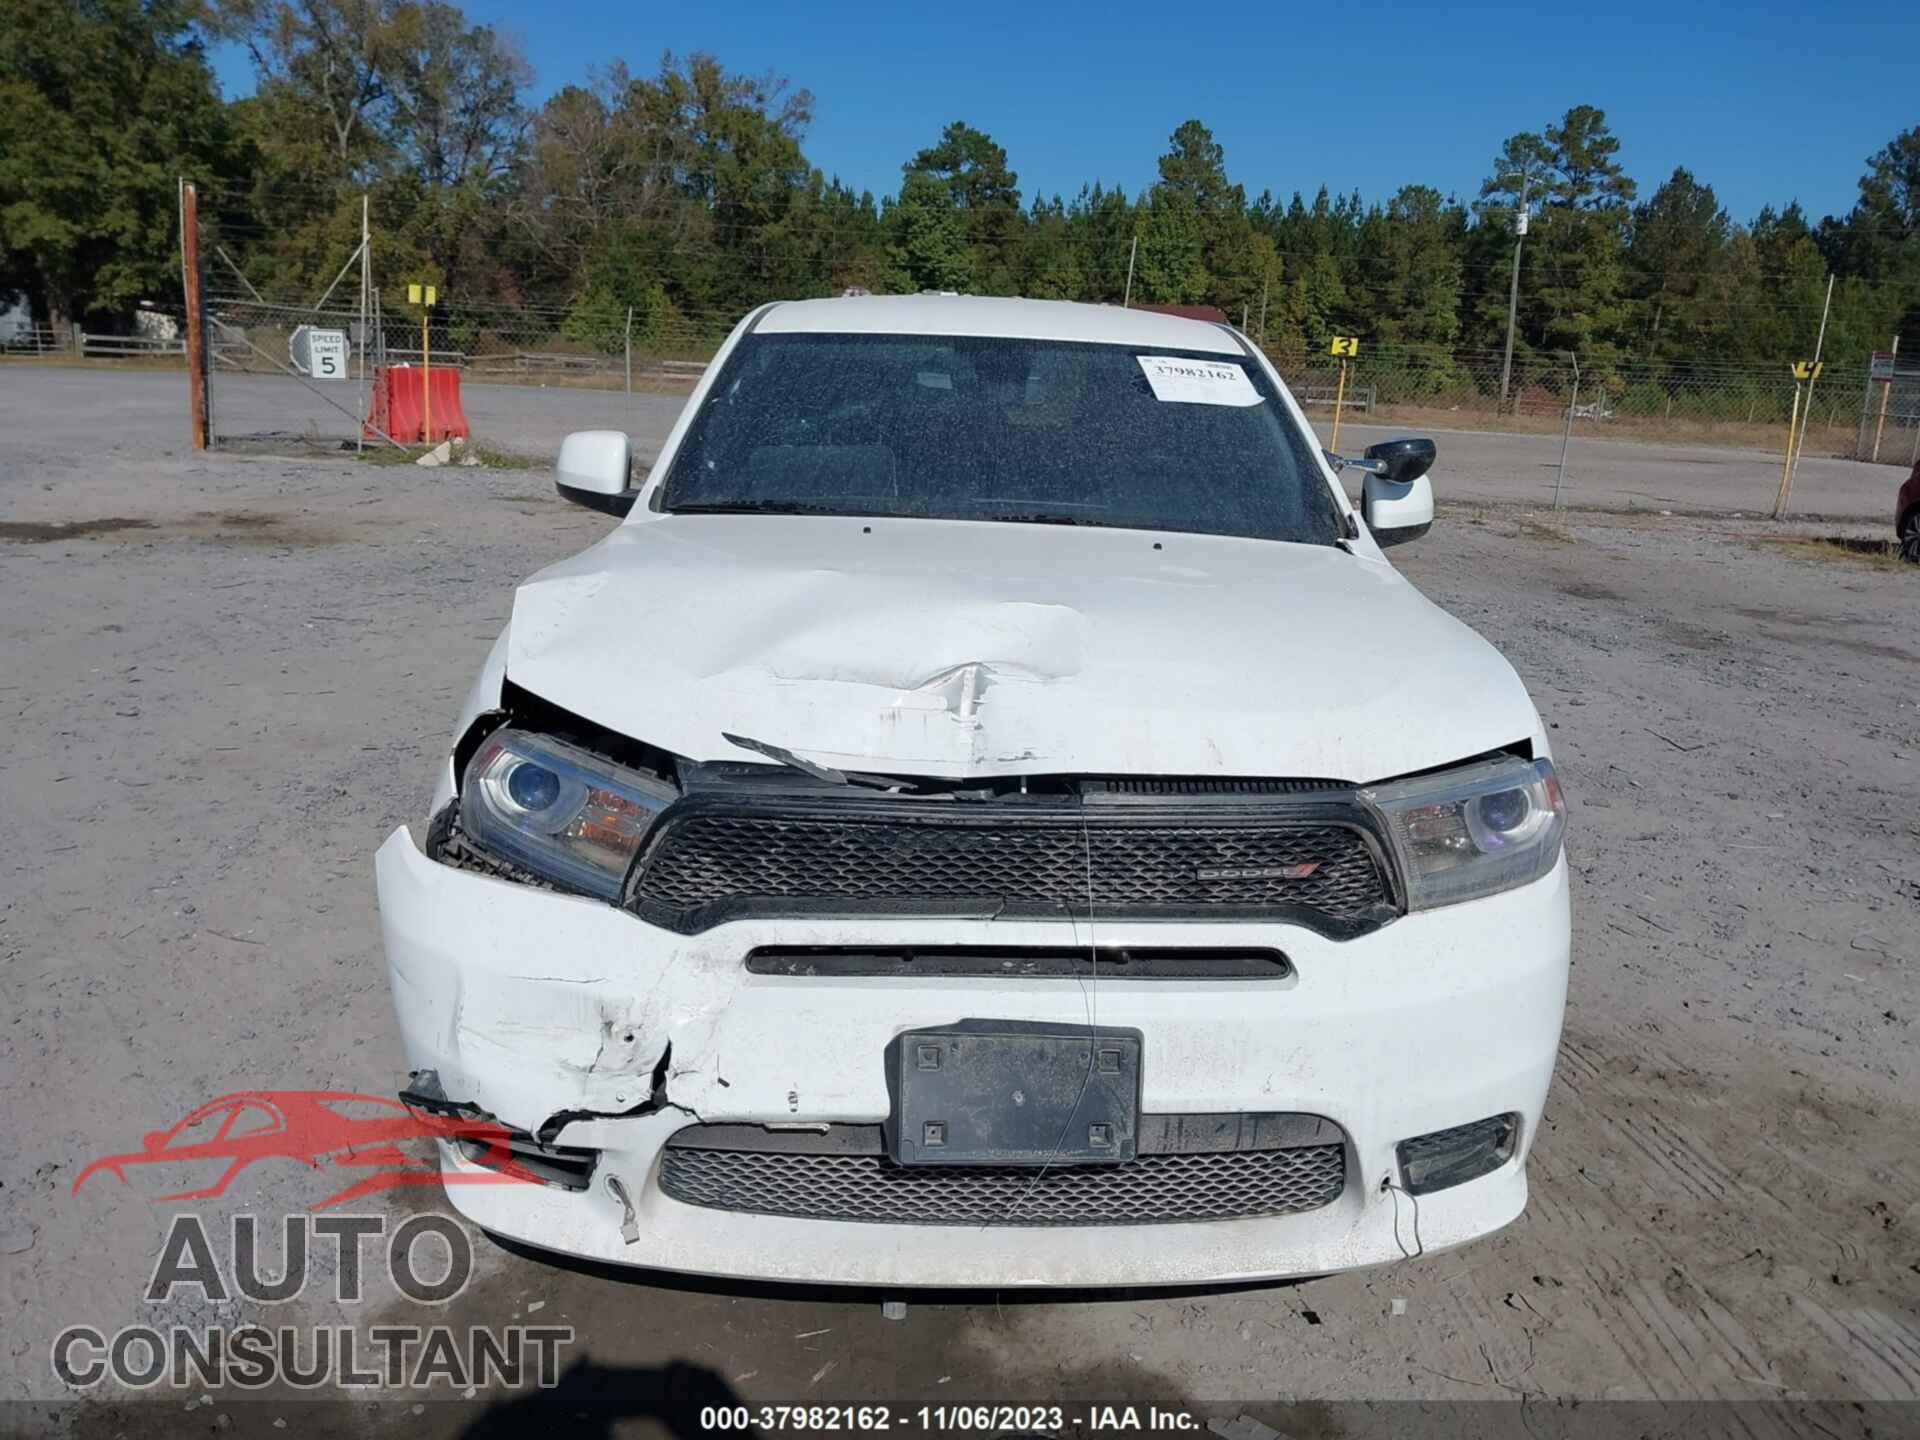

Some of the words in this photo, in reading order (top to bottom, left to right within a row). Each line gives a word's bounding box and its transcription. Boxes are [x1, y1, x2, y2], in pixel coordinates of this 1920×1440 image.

[311, 334, 341, 344] SPEED
[314, 346, 338, 354] LIMIT
[321, 356, 336, 374] 5
[1155, 365, 1237, 381] 37982162
